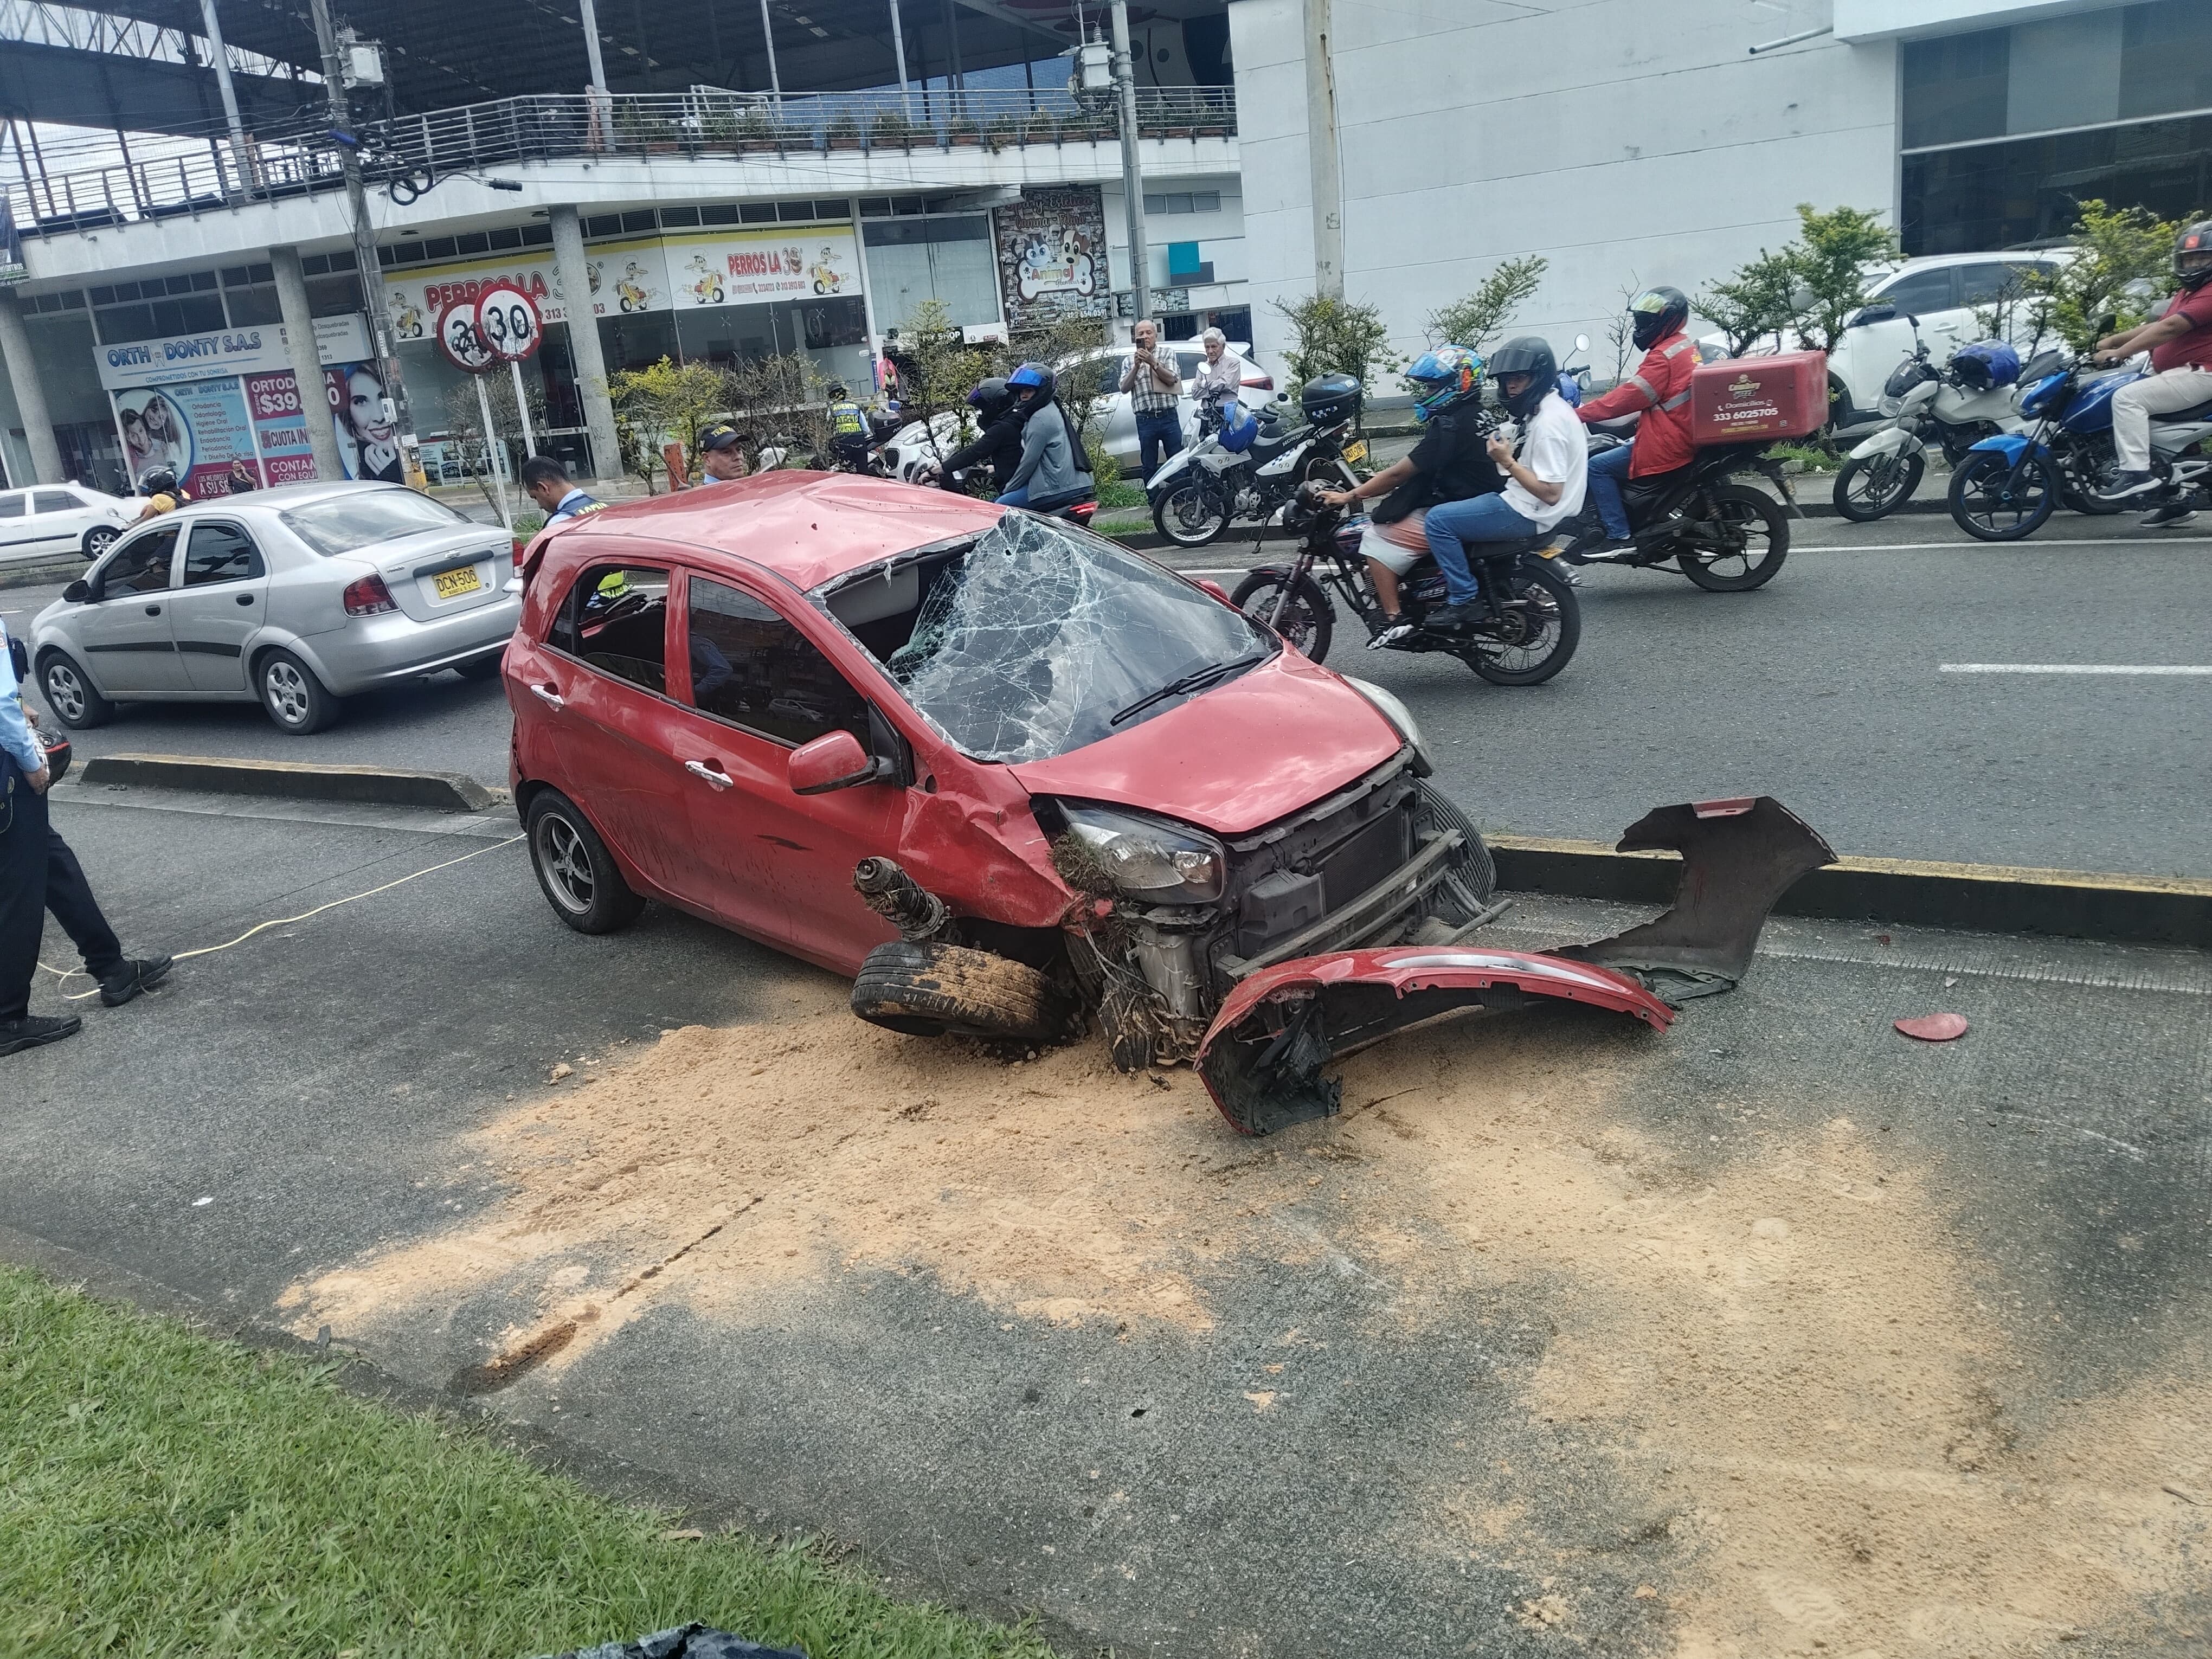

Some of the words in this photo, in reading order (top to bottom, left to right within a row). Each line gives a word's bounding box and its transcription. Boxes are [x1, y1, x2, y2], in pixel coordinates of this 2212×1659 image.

[1015, 216, 1050, 229] Canina
[1058, 212, 1085, 226] Felina
[727, 251, 767, 278] PERROS
[767, 250, 781, 275] LA
[1032, 264, 1074, 281] Animal
[546, 308, 561, 320] 313
[1080, 310, 1092, 318] 654
[1093, 308, 1107, 317] 0591
[318, 320, 350, 330] Dosquebradas
[488, 305, 529, 341] 30
[222, 331, 262, 352] S.A.S
[145, 373, 187, 383] COMPROMETIDOS
[207, 367, 229, 376] SONRISA
[191, 401, 221, 410] Ortodoncia
[1725, 400, 1766, 409] Domicilios
[1713, 413, 1731, 421] 333
[1733, 407, 1779, 419] 6025705
[200, 435, 231, 444] Endodoncia
[271, 430, 297, 446] CUOTA
[1282, 433, 1305, 447] HONDA
[207, 473, 225, 481] MEJORES
[278, 473, 298, 482] CON
[200, 483, 206, 496] A
[206, 481, 218, 494] SU
